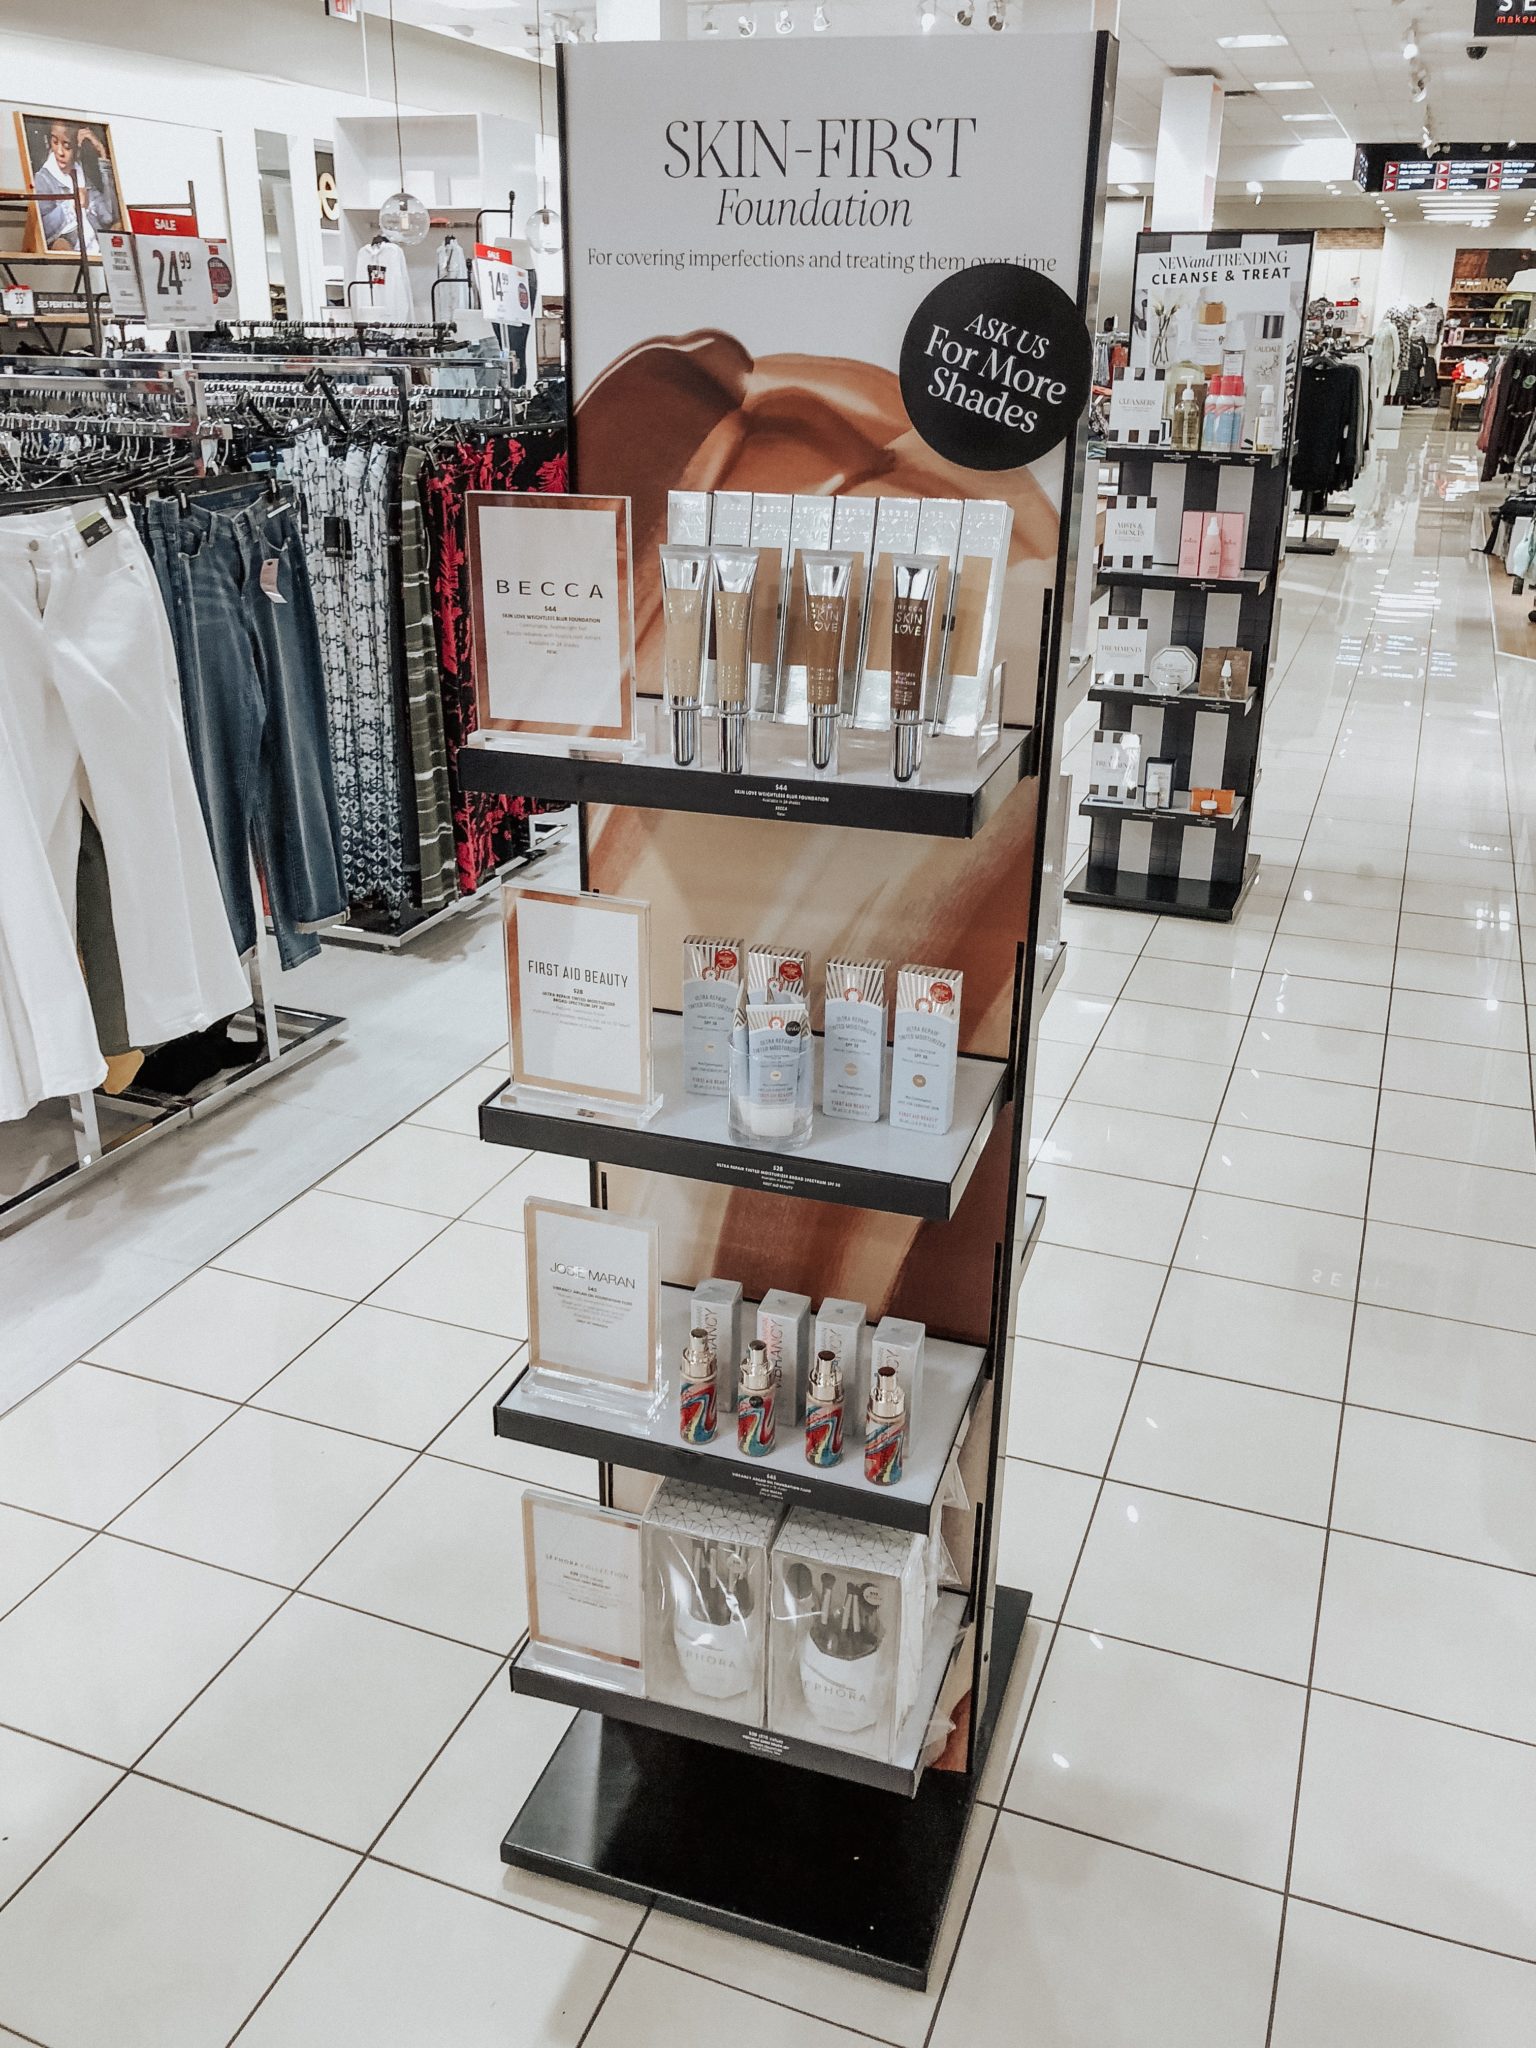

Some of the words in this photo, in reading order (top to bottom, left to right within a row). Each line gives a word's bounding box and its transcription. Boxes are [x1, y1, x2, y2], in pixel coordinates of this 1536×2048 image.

[664, 118, 977, 179] SKIN-FIRST
[716, 188, 913, 227] Foundation
[154, 218, 177, 231] SALE
[588, 248, 612, 266] For
[615, 249, 686, 271] covering
[688, 249, 805, 271] imperfections
[808, 251, 842, 269] and
[845, 252, 916, 274] treating
[919, 251, 966, 271] them
[1015, 253, 1058, 272] time
[1151, 270, 1219, 285] CLEANSE
[1224, 270, 1236, 281] &
[1241, 266, 1292, 281] TREAT
[964, 313, 1016, 347] ASK
[1016, 330, 1050, 360] US
[923, 323, 979, 371] For
[977, 346, 1067, 405] More
[927, 366, 1038, 433] Shades
[496, 579, 603, 599] BECCA
[894, 623, 922, 637] LOVE
[896, 612, 923, 625] SKIN
[528, 960, 559, 977] FIRST
[562, 966, 581, 981] AID
[585, 969, 629, 988] BEAUTY
[588, 1269, 635, 1289] MARAN
